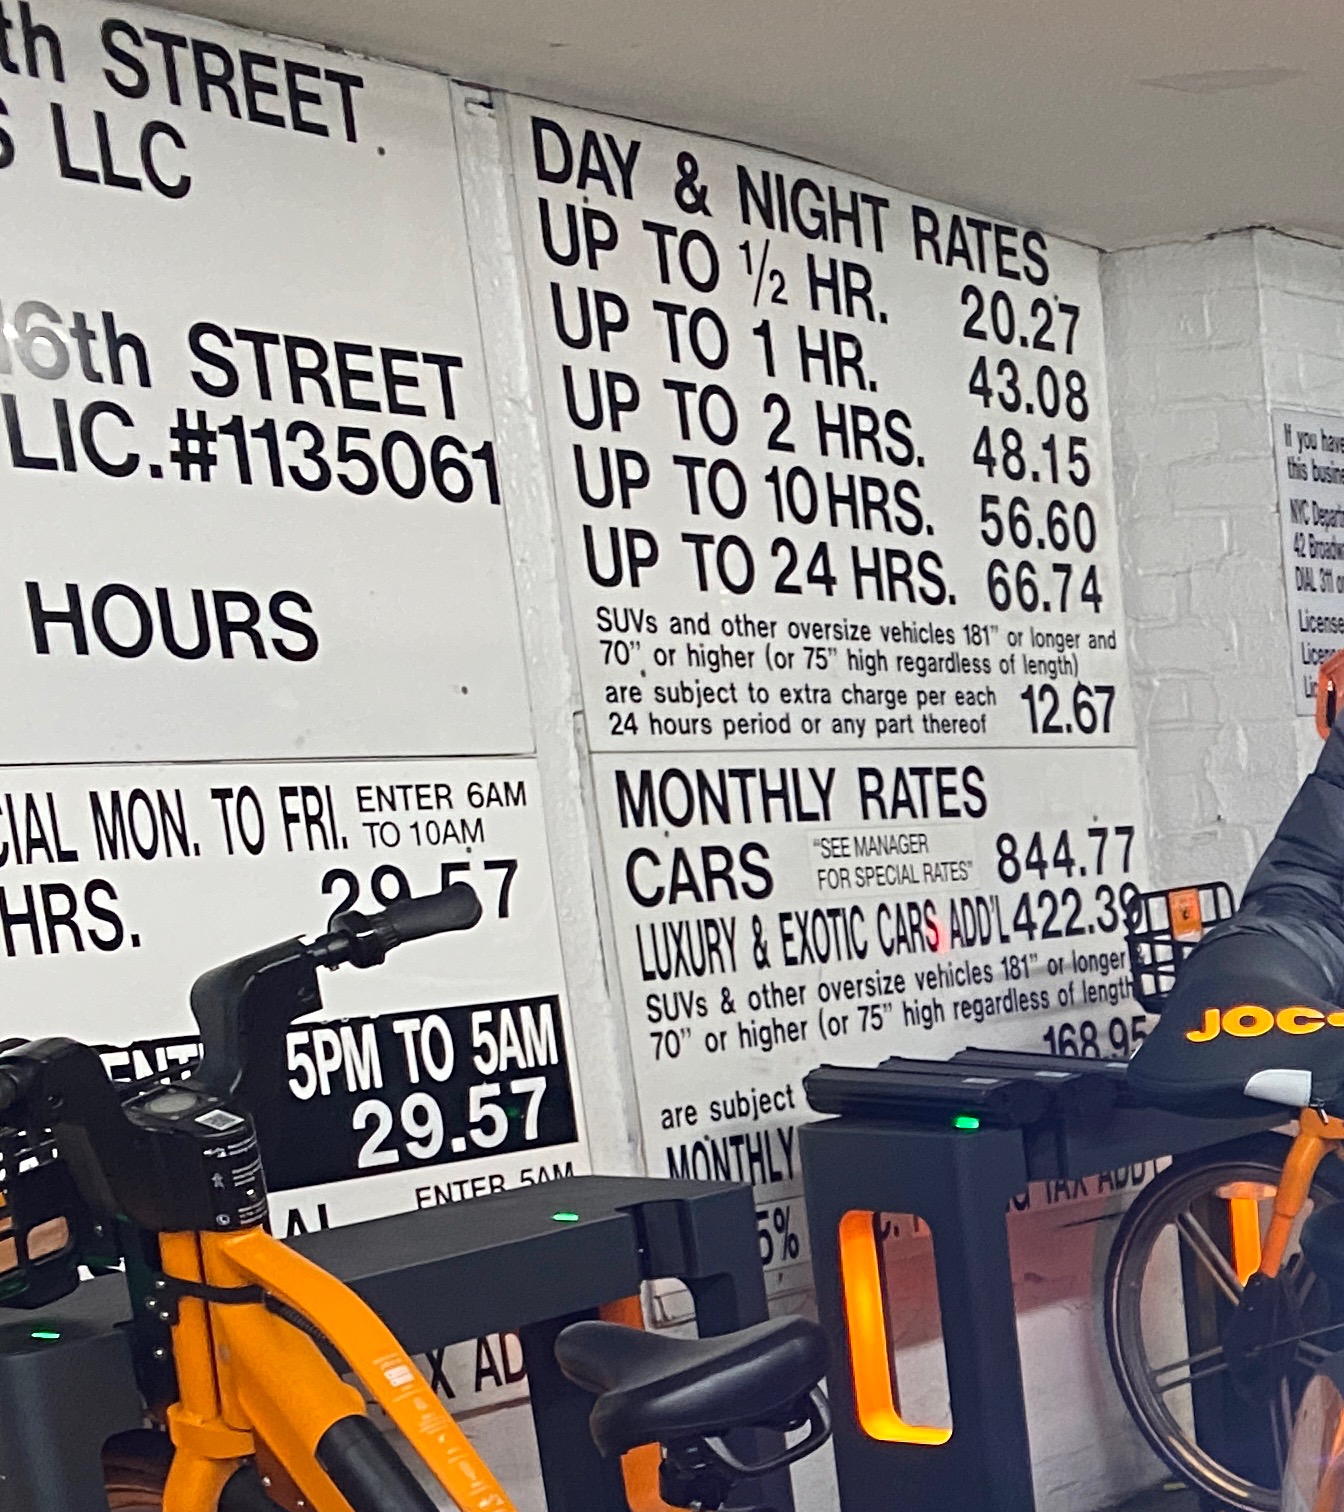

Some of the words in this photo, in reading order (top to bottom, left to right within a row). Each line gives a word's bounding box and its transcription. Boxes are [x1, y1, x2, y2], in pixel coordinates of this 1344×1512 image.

[101, 18, 364, 143] STREET
[50, 102, 191, 199] LLC
[531, 116, 641, 200] DAY
[674, 152, 712, 217] &
[737, 165, 889, 253] NIGHT
[912, 205, 1049, 286] RATES
[538, 197, 618, 269] UP
[642, 221, 719, 292] TO
[807, 254, 888, 324] HR.
[960, 284, 1080, 355] 20.27
[188, 321, 463, 420] STREET
[551, 282, 629, 352] UP
[653, 299, 729, 370] TO
[753, 319, 775, 377] 1
[799, 325, 877, 392] HR.
[969, 355, 1089, 423] 43.08
[562, 365, 641, 432] UP
[664, 378, 738, 446] TO
[763, 393, 795, 453] 2
[815, 400, 925, 467] HRS.
[973, 425, 1091, 487] 48.15
[1297, 431, 1317, 454] you
[573, 444, 650, 509] UP
[673, 455, 747, 519] TO
[764, 465, 818, 525] 10
[826, 472, 935, 537] HRS.
[980, 495, 1097, 554] 56.60
[1287, 455, 1308, 481] this
[583, 524, 659, 588] UP
[681, 532, 755, 595] TO
[770, 537, 837, 597] 24
[850, 545, 956, 606] HRS.
[987, 558, 1103, 614] 66.74
[25, 581, 319, 661] HOURS
[596, 606, 658, 635] SUVs
[669, 610, 709, 636] and
[721, 613, 777, 640] other
[788, 617, 871, 643] oversize
[880, 620, 955, 647] vehicles
[1006, 630, 1024, 648] or
[1029, 626, 1081, 654] longer
[1087, 627, 1117, 651] and
[605, 681, 641, 703] are
[654, 680, 738, 711] subject
[748, 683, 769, 705] to
[780, 684, 831, 706] extra
[842, 684, 906, 714] charge
[916, 687, 947, 711] per
[955, 686, 997, 707] each
[653, 647, 677, 668] or
[687, 642, 755, 674] higher
[765, 646, 795, 673] (or
[847, 647, 887, 678] high
[896, 650, 992, 682] regardless
[999, 654, 1017, 676] of
[1022, 653, 1079, 680] length)
[609, 713, 638, 736] 24
[649, 713, 712, 735] hours
[723, 713, 790, 739] period
[801, 717, 822, 735] or
[831, 717, 866, 740] any
[875, 716, 914, 739] part
[923, 713, 987, 735] thereof
[1020, 683, 1116, 736] 12.67
[89, 787, 201, 861] MON.
[211, 785, 265, 855] TO
[282, 785, 348, 852] FRI.
[357, 784, 453, 813] ENTER
[468, 781, 527, 810] 6AM
[363, 820, 400, 849] TO
[410, 817, 485, 846] 10AM
[615, 767, 836, 829] MONTHLY
[857, 765, 989, 820] RATES
[625, 841, 774, 908] CARS
[817, 868, 851, 891] FOR
[855, 866, 919, 888] SPECIAL
[854, 833, 929, 857] MANAGER
[996, 825, 1136, 884] 844.77
[0, 878, 141, 957] HRS.
[636, 917, 736, 982] LUXURY
[752, 915, 769, 969] &
[780, 905, 868, 968] EXOTIC
[877, 901, 940, 956] CARS
[949, 894, 1011, 949] ADD'L
[1012, 881, 1143, 943] 422.39
[646, 993, 708, 1024] SUVs
[720, 988, 737, 1014] &
[748, 982, 806, 1012] other
[818, 971, 906, 1003] oversize
[914, 962, 994, 993] vehicles
[1046, 956, 1066, 976] or
[1071, 949, 1126, 977] longer
[704, 1031, 728, 1054] or
[739, 1021, 808, 1054] higher
[818, 1014, 849, 1040] (or
[902, 996, 945, 1031] high
[953, 990, 1050, 1026] regardless
[1057, 981, 1075, 1008] of
[285, 1022, 384, 1100] 5PM
[393, 1017, 454, 1084] TO
[471, 1003, 559, 1076] 5AM
[352, 1077, 548, 1169] 29.57
[660, 1102, 698, 1129] are
[709, 1084, 796, 1122] subject
[666, 1126, 794, 1186] MONTHLY
